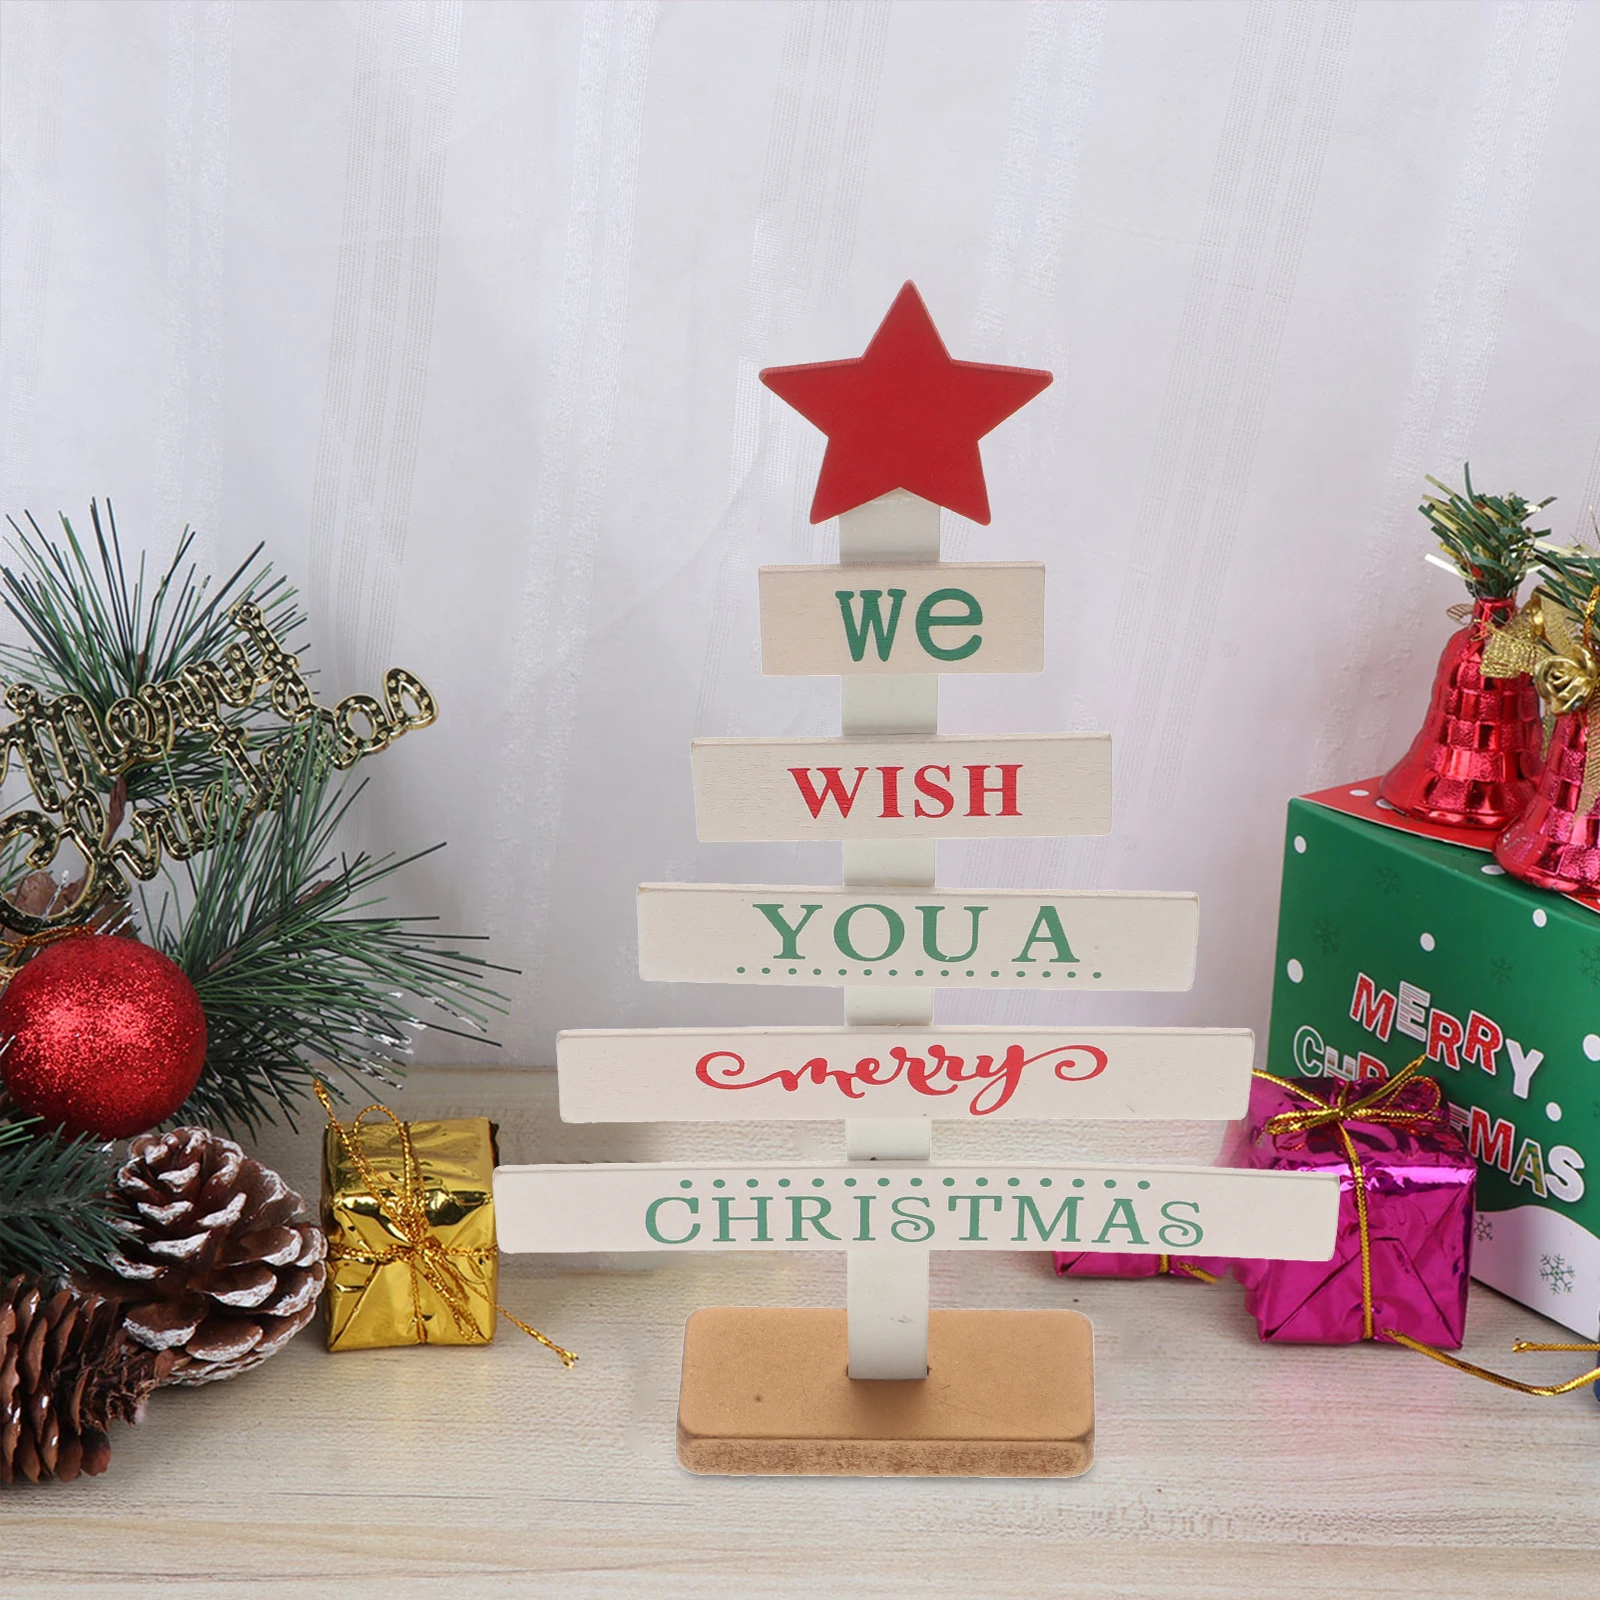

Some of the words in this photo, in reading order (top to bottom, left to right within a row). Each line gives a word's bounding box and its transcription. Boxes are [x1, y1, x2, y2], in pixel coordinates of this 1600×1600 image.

[787, 763, 1024, 819] WISH
[752, 903, 989, 962] YOU
[1012, 905, 1080, 963] A
[1349, 972, 1544, 1100] MERRY
[695, 1044, 1108, 1116] merry
[1293, 1024, 1586, 1203] CHMAS
[645, 1195, 1205, 1248] CHRISTMAS
